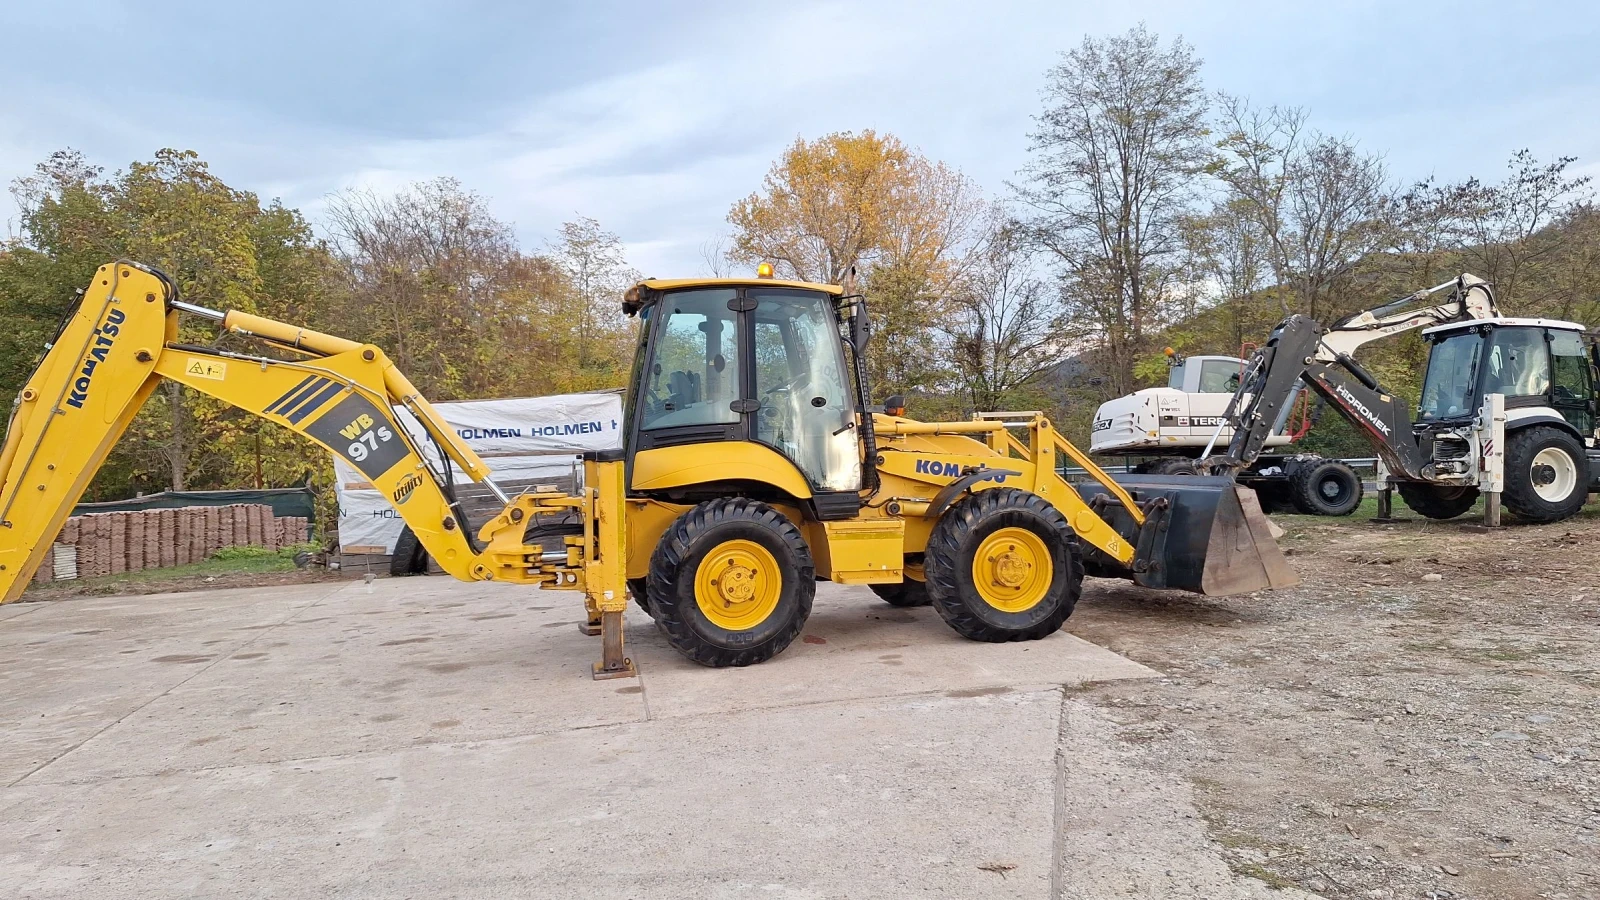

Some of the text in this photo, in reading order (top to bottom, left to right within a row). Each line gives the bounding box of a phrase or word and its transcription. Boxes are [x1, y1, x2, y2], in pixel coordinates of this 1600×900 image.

[339, 413, 374, 440] WB
[532, 421, 602, 436] HOLMEN
[393, 473, 423, 502] Utility
